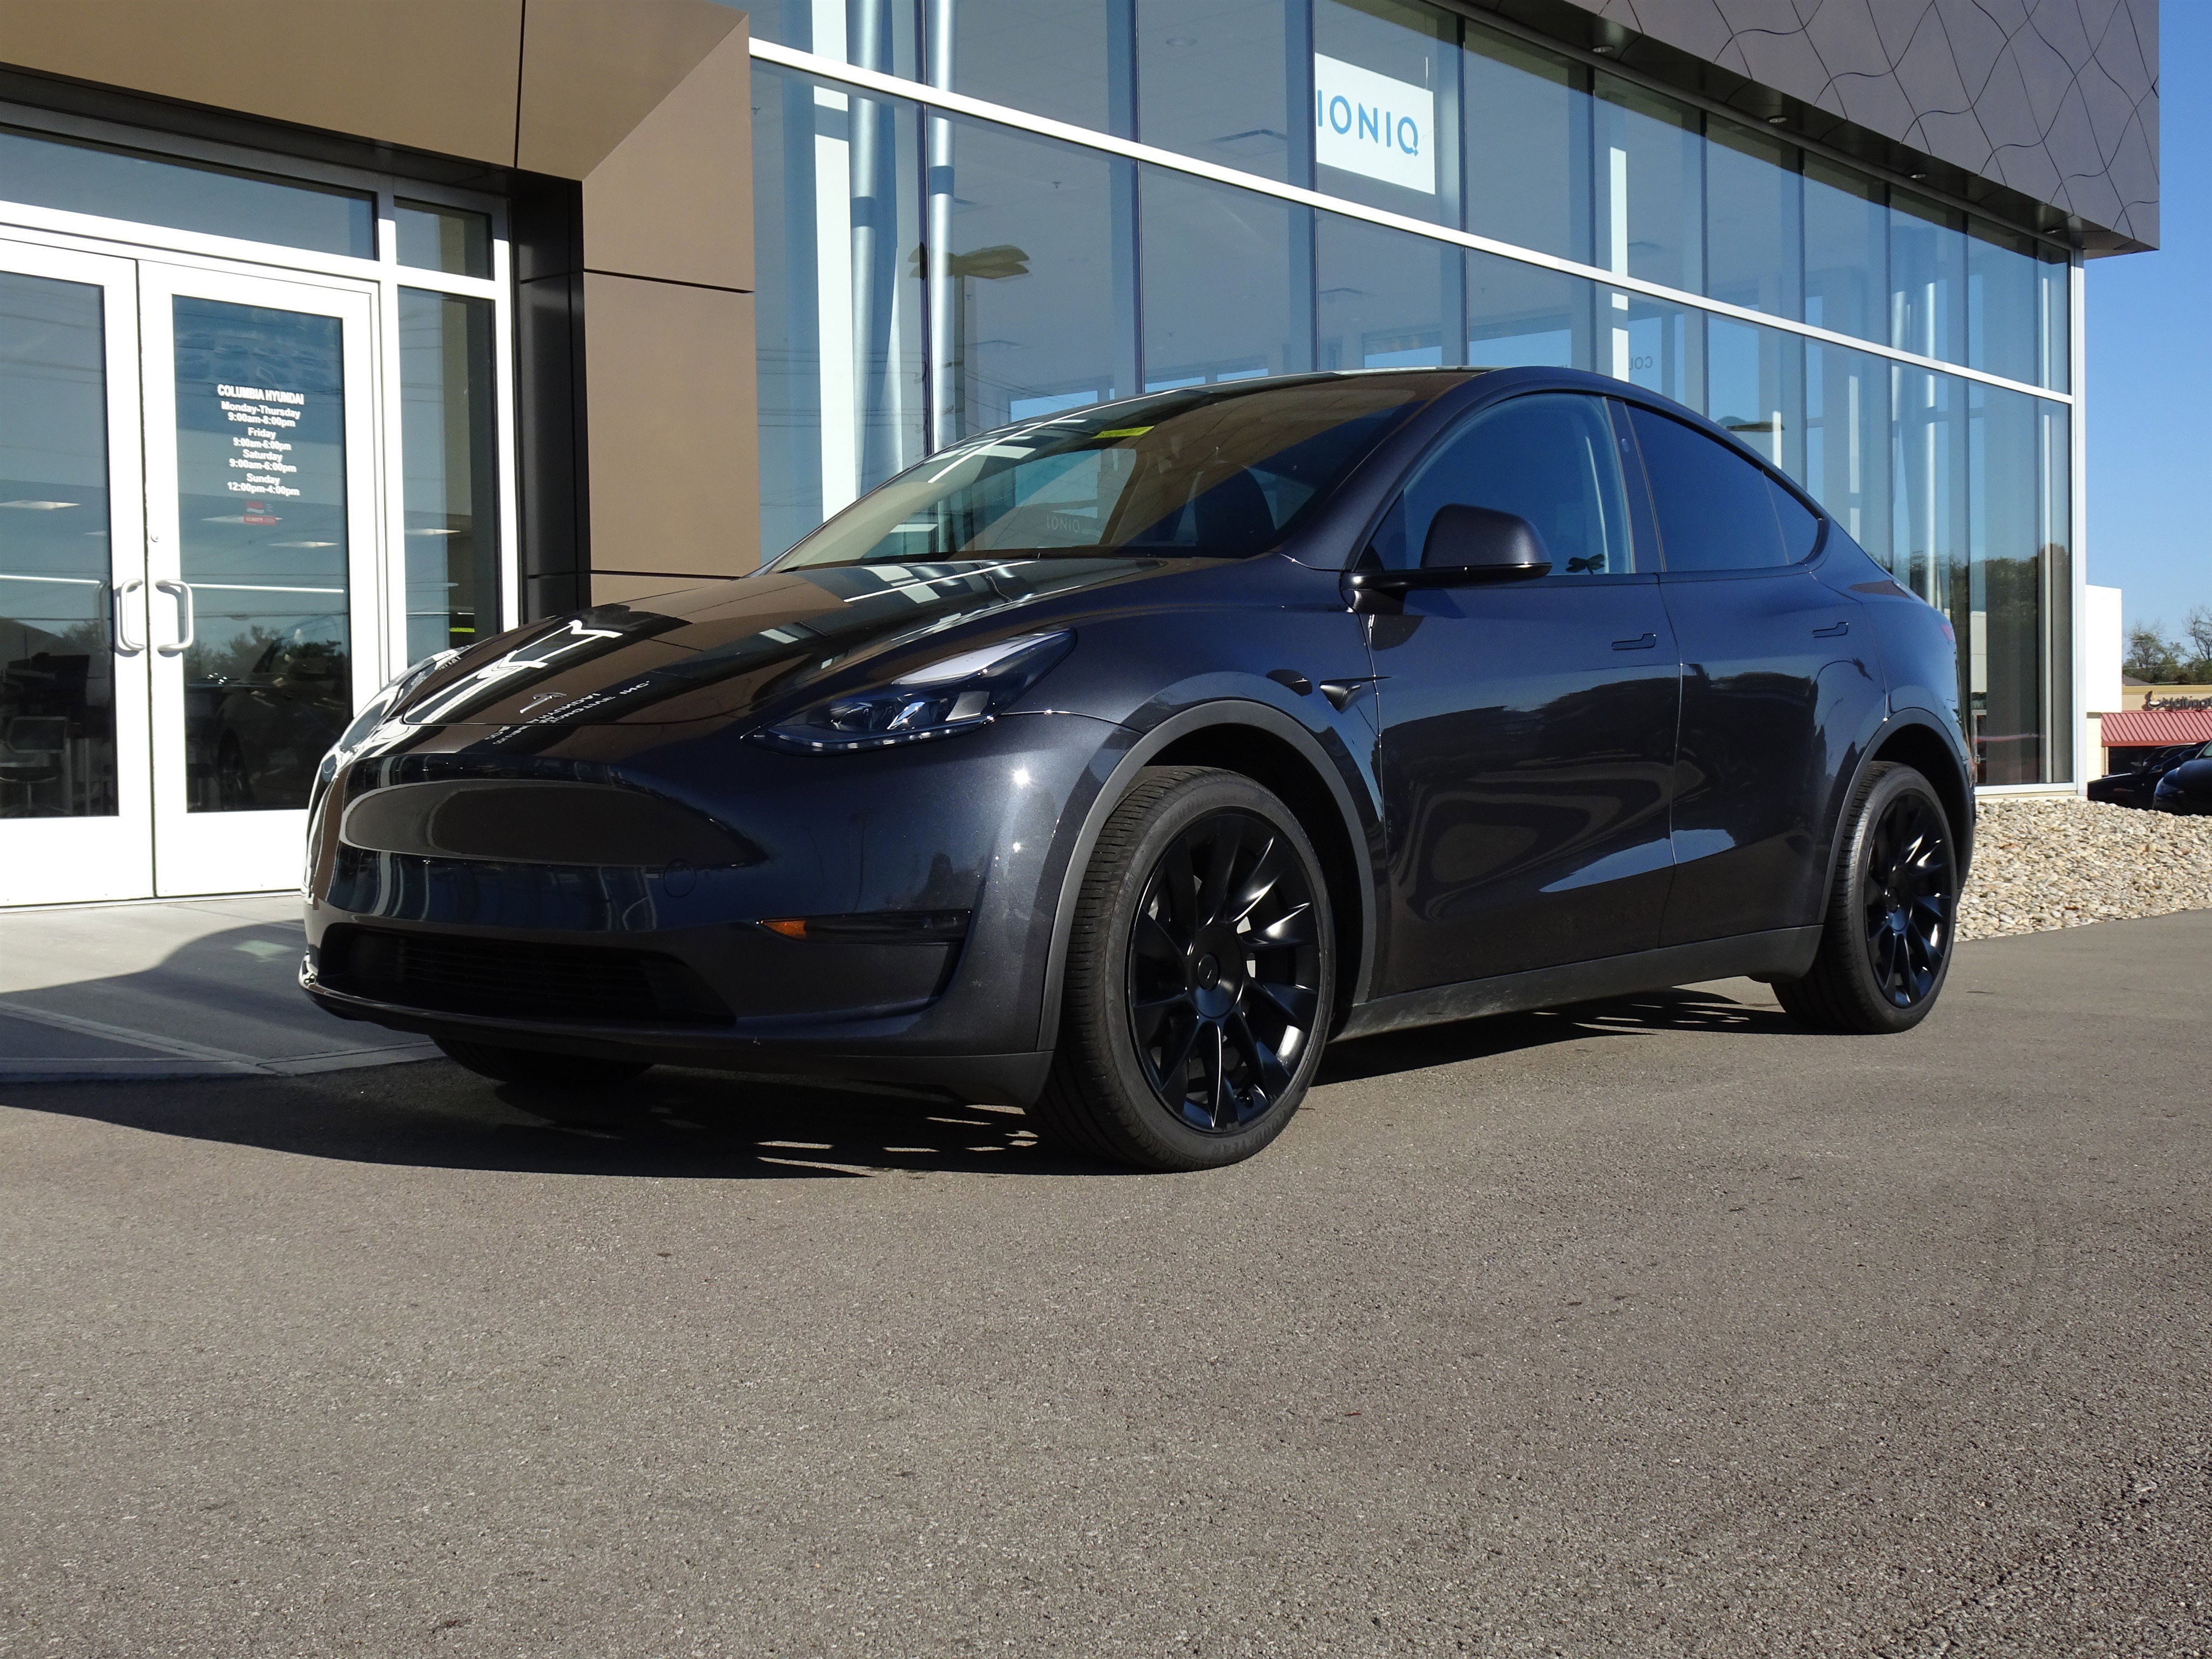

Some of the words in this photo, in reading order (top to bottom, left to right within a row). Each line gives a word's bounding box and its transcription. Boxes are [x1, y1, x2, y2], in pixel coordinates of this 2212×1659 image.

[1317, 90, 1418, 157] IONIQ
[218, 384, 265, 401] COLUMBIA
[265, 389, 305, 405] HYUNDAI
[221, 401, 301, 420] Monday-Thursday
[228, 412, 295, 427] 9:00am-8:00pm
[248, 427, 276, 440] Friday
[233, 437, 292, 450] 9:00am-6:00pm
[243, 449, 283, 462] Saturday
[229, 458, 297, 473] 9:00am-6:00pm
[246, 473, 280, 485] Sunday
[227, 481, 300, 497] 12:00pm-4:00pm
